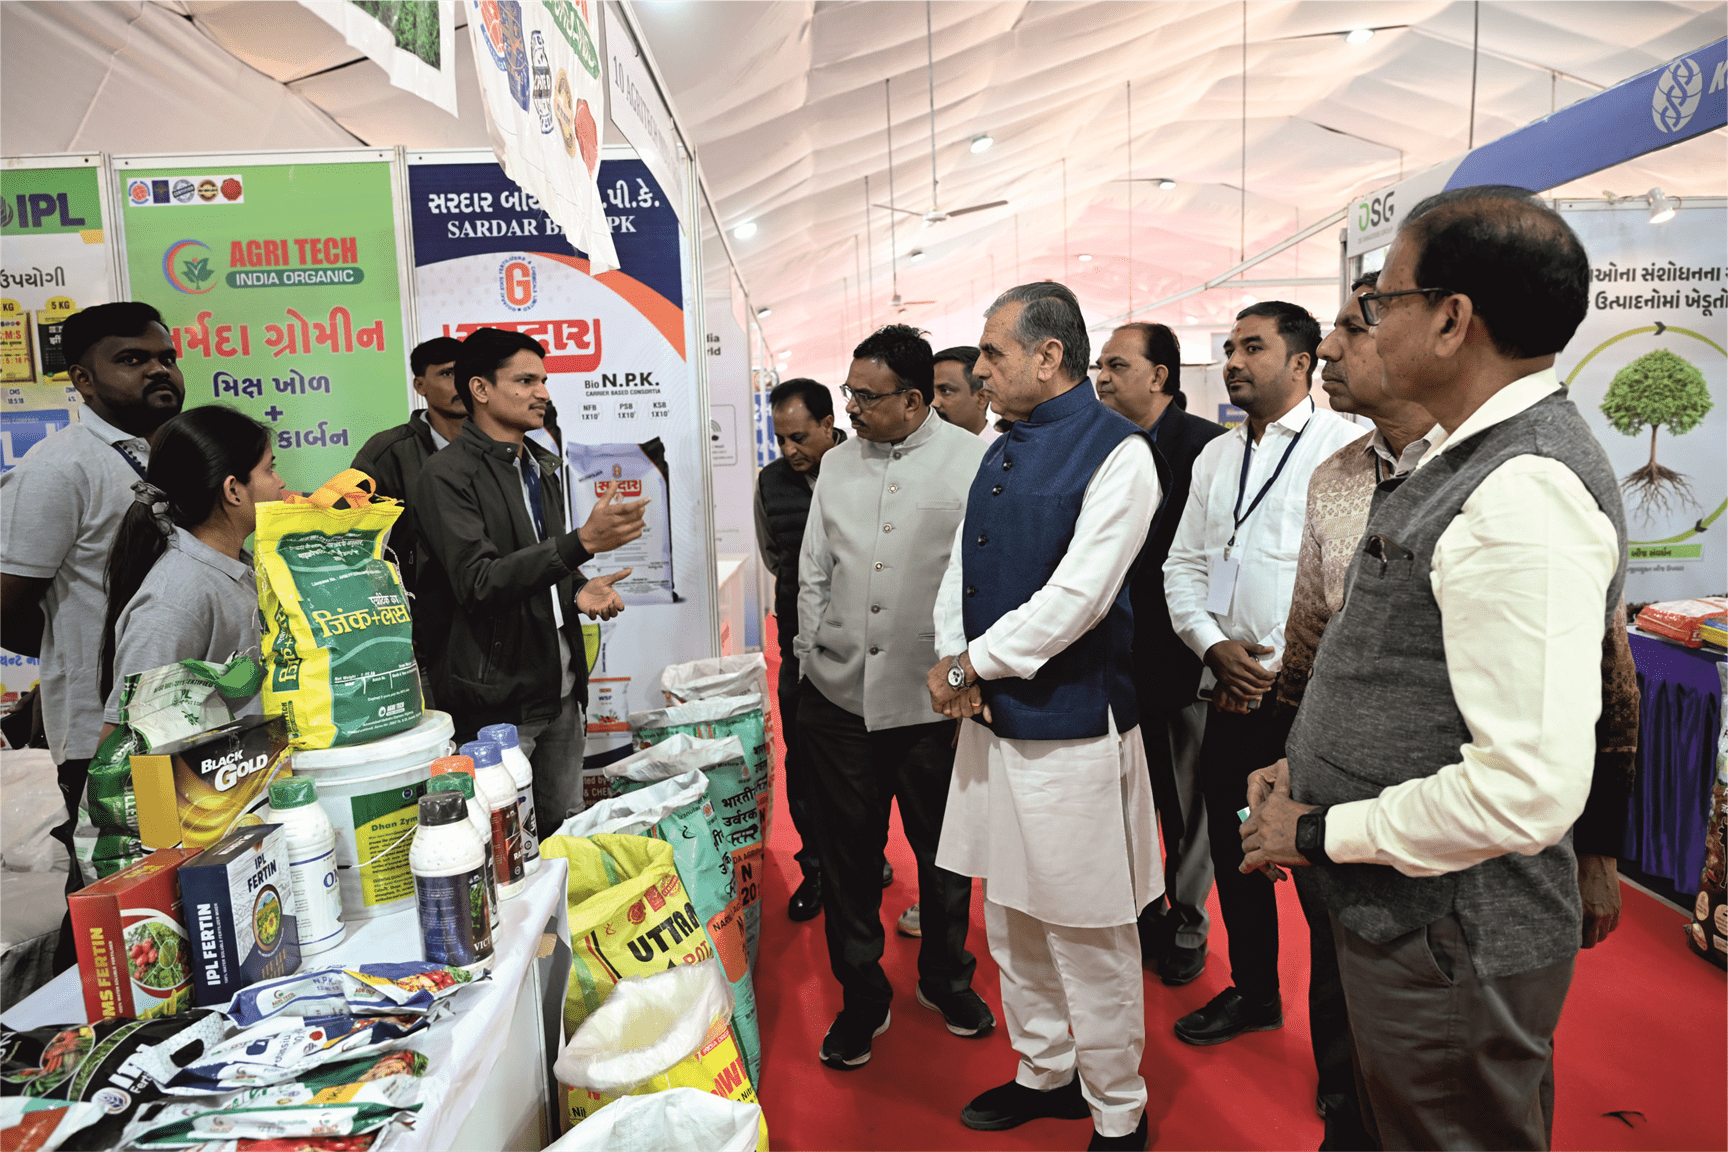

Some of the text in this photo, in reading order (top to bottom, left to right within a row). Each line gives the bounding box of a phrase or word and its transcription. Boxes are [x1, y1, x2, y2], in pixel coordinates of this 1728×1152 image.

[16, 193, 86, 228] IPL
[428, 192, 493, 214] સરદાર
[447, 219, 539, 239] SARDAR
[544, 218, 567, 236] B
[230, 236, 358, 268] AGRI TECH
[236, 269, 355, 286] INDIA ORGANIC
[1641, 260, 1721, 282] સંશોધનના
[3, 303, 14, 311] KG
[51, 301, 70, 310] 5 KG
[1595, 288, 1680, 310] ઉત્પાદનોમાં
[264, 305, 386, 358] ગ્રોમીન
[213, 368, 331, 399] મિક્ષ ખોળ
[584, 372, 660, 389] Bio N.P.K.
[264, 405, 284, 421] +
[278, 421, 350, 449] કાર્બન
[598, 480, 639, 491] सदार
[201, 750, 268, 792] BLACK GOLD
[371, 822, 397, 831] Dhan
[722, 807, 757, 827] उर्वरक
[254, 853, 267, 870] IPL
[741, 863, 753, 882] N
[247, 859, 277, 893] FERTIN
[741, 883, 757, 906] 20
[197, 903, 221, 986] IPL FERTIN
[89, 927, 116, 1020] MS FERTIN
